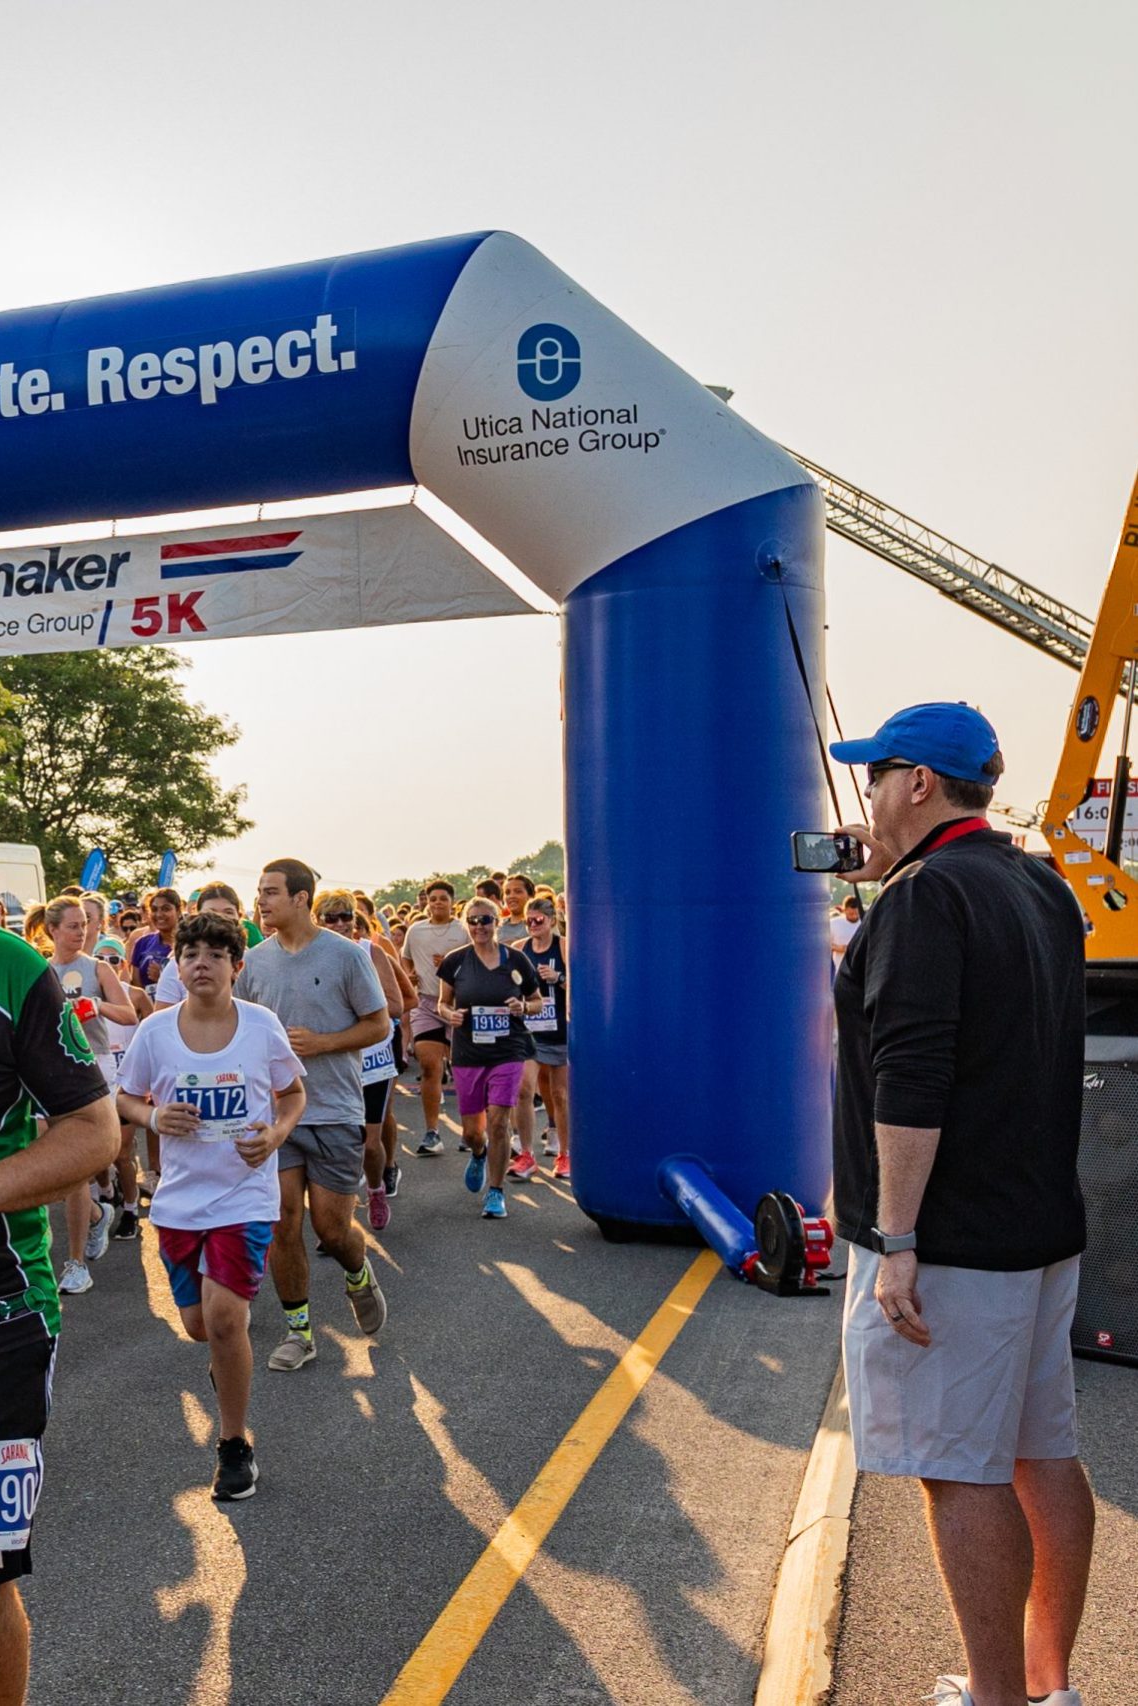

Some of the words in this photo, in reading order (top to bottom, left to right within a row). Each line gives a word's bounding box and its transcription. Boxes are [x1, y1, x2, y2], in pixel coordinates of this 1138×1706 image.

[87, 313, 356, 405] Respect.
[462, 415, 523, 441] Utica
[531, 404, 638, 431] National
[457, 437, 569, 467] Insurance
[130, 590, 208, 637] 5K
[472, 1015, 511, 1030] 19138
